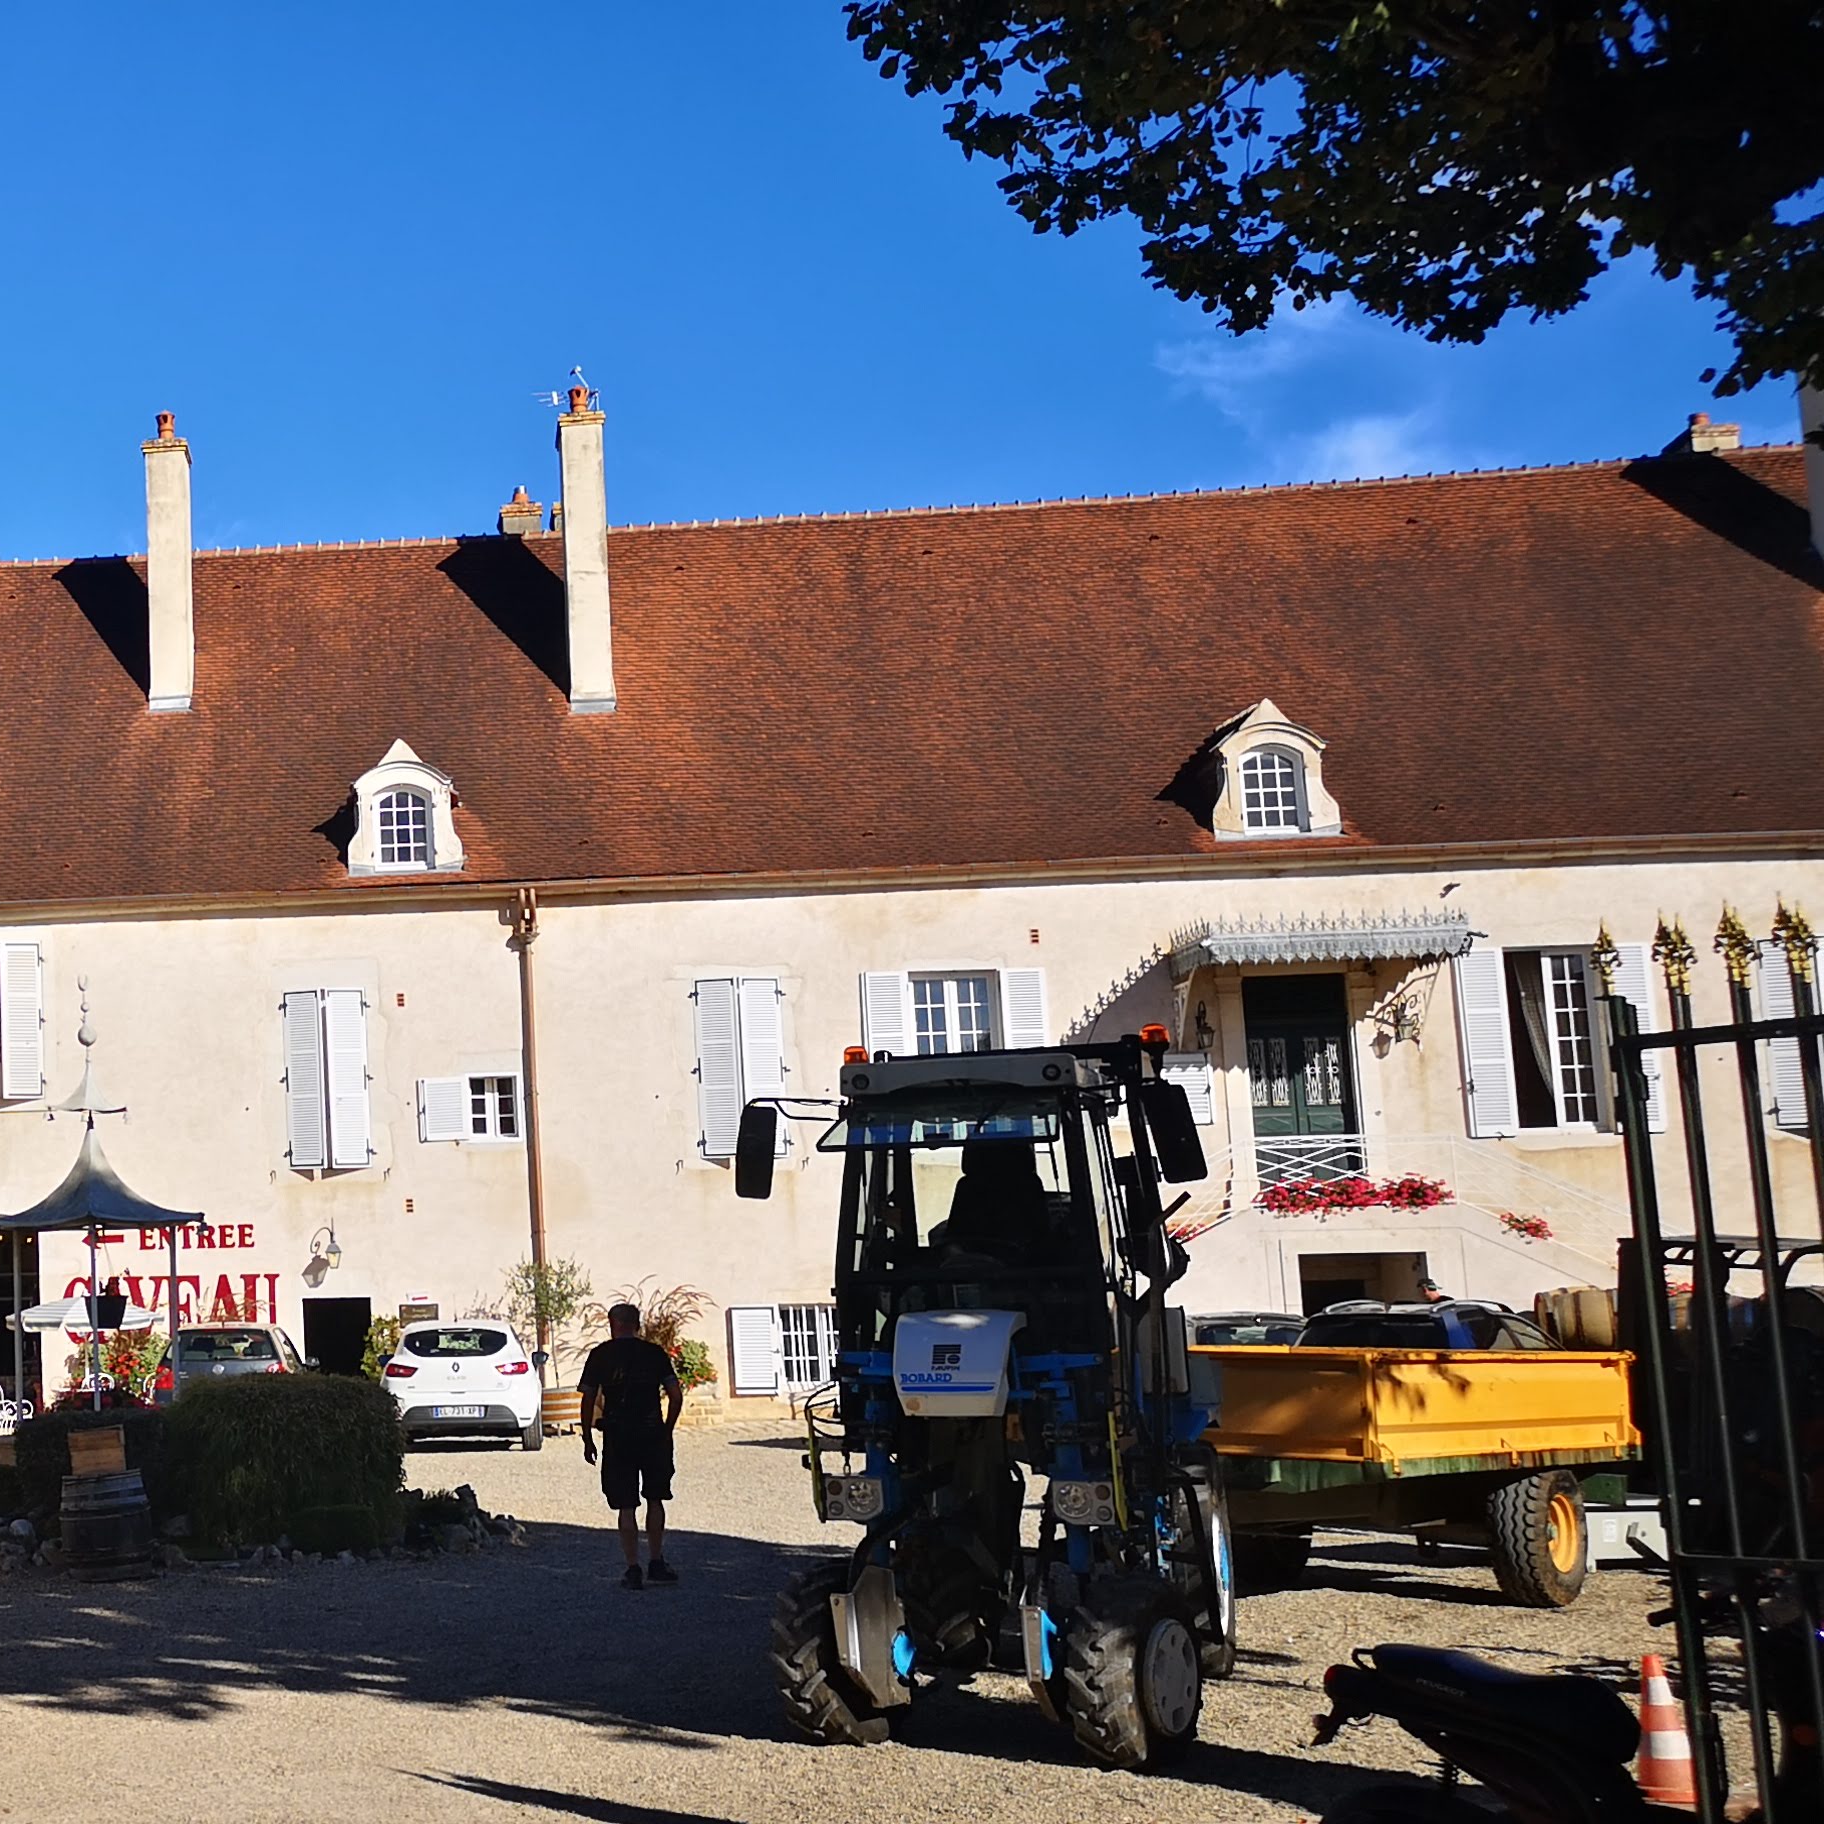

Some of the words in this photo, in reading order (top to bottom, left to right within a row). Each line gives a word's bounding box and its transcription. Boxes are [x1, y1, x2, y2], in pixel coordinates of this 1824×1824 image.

[139, 1224, 255, 1250] ENTREE
[63, 1273, 280, 1344] CVEAU
[900, 1373, 952, 1383] BOBARD
